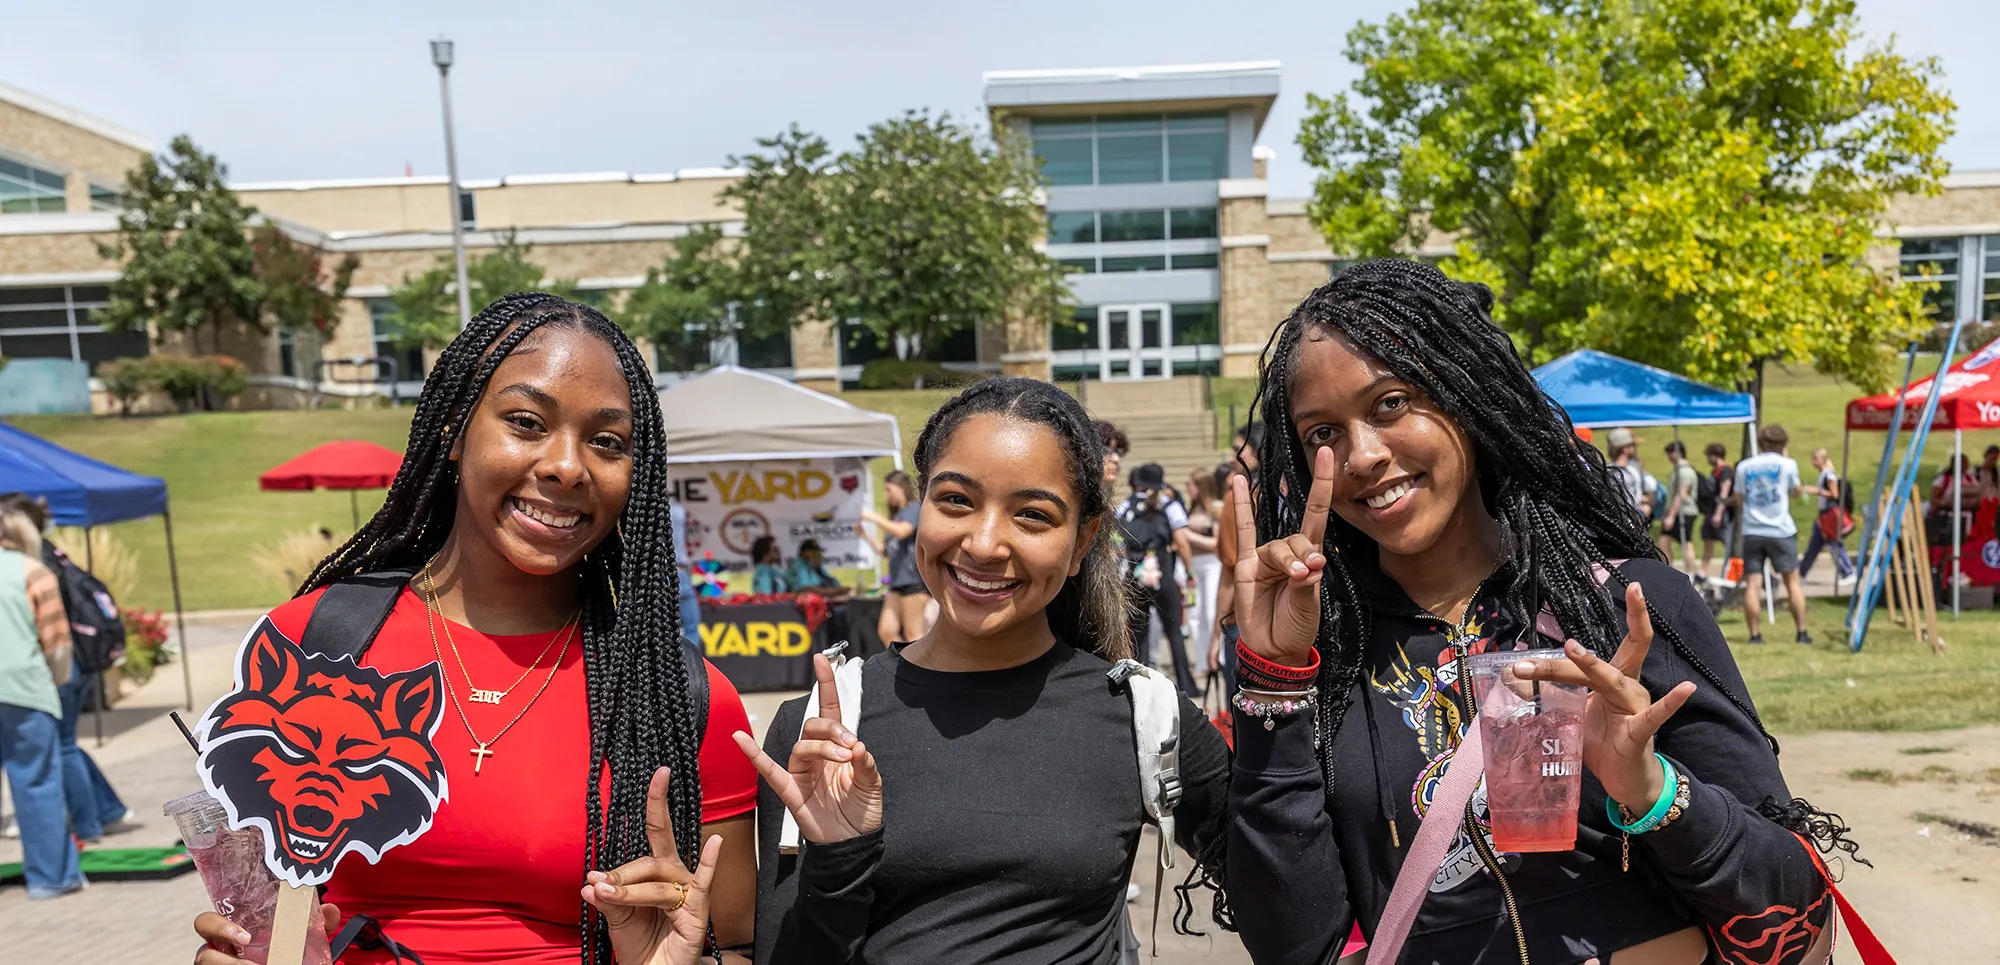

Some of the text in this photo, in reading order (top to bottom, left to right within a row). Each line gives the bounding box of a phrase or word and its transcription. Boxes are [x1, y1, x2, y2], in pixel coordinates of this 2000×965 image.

[711, 471, 832, 504] YARD
[698, 622, 812, 657] YARD
[1236, 643, 1267, 670] CAMPUS
[1241, 667, 1300, 690] OF ENGINEERING
[1435, 851, 1478, 885] CITY
